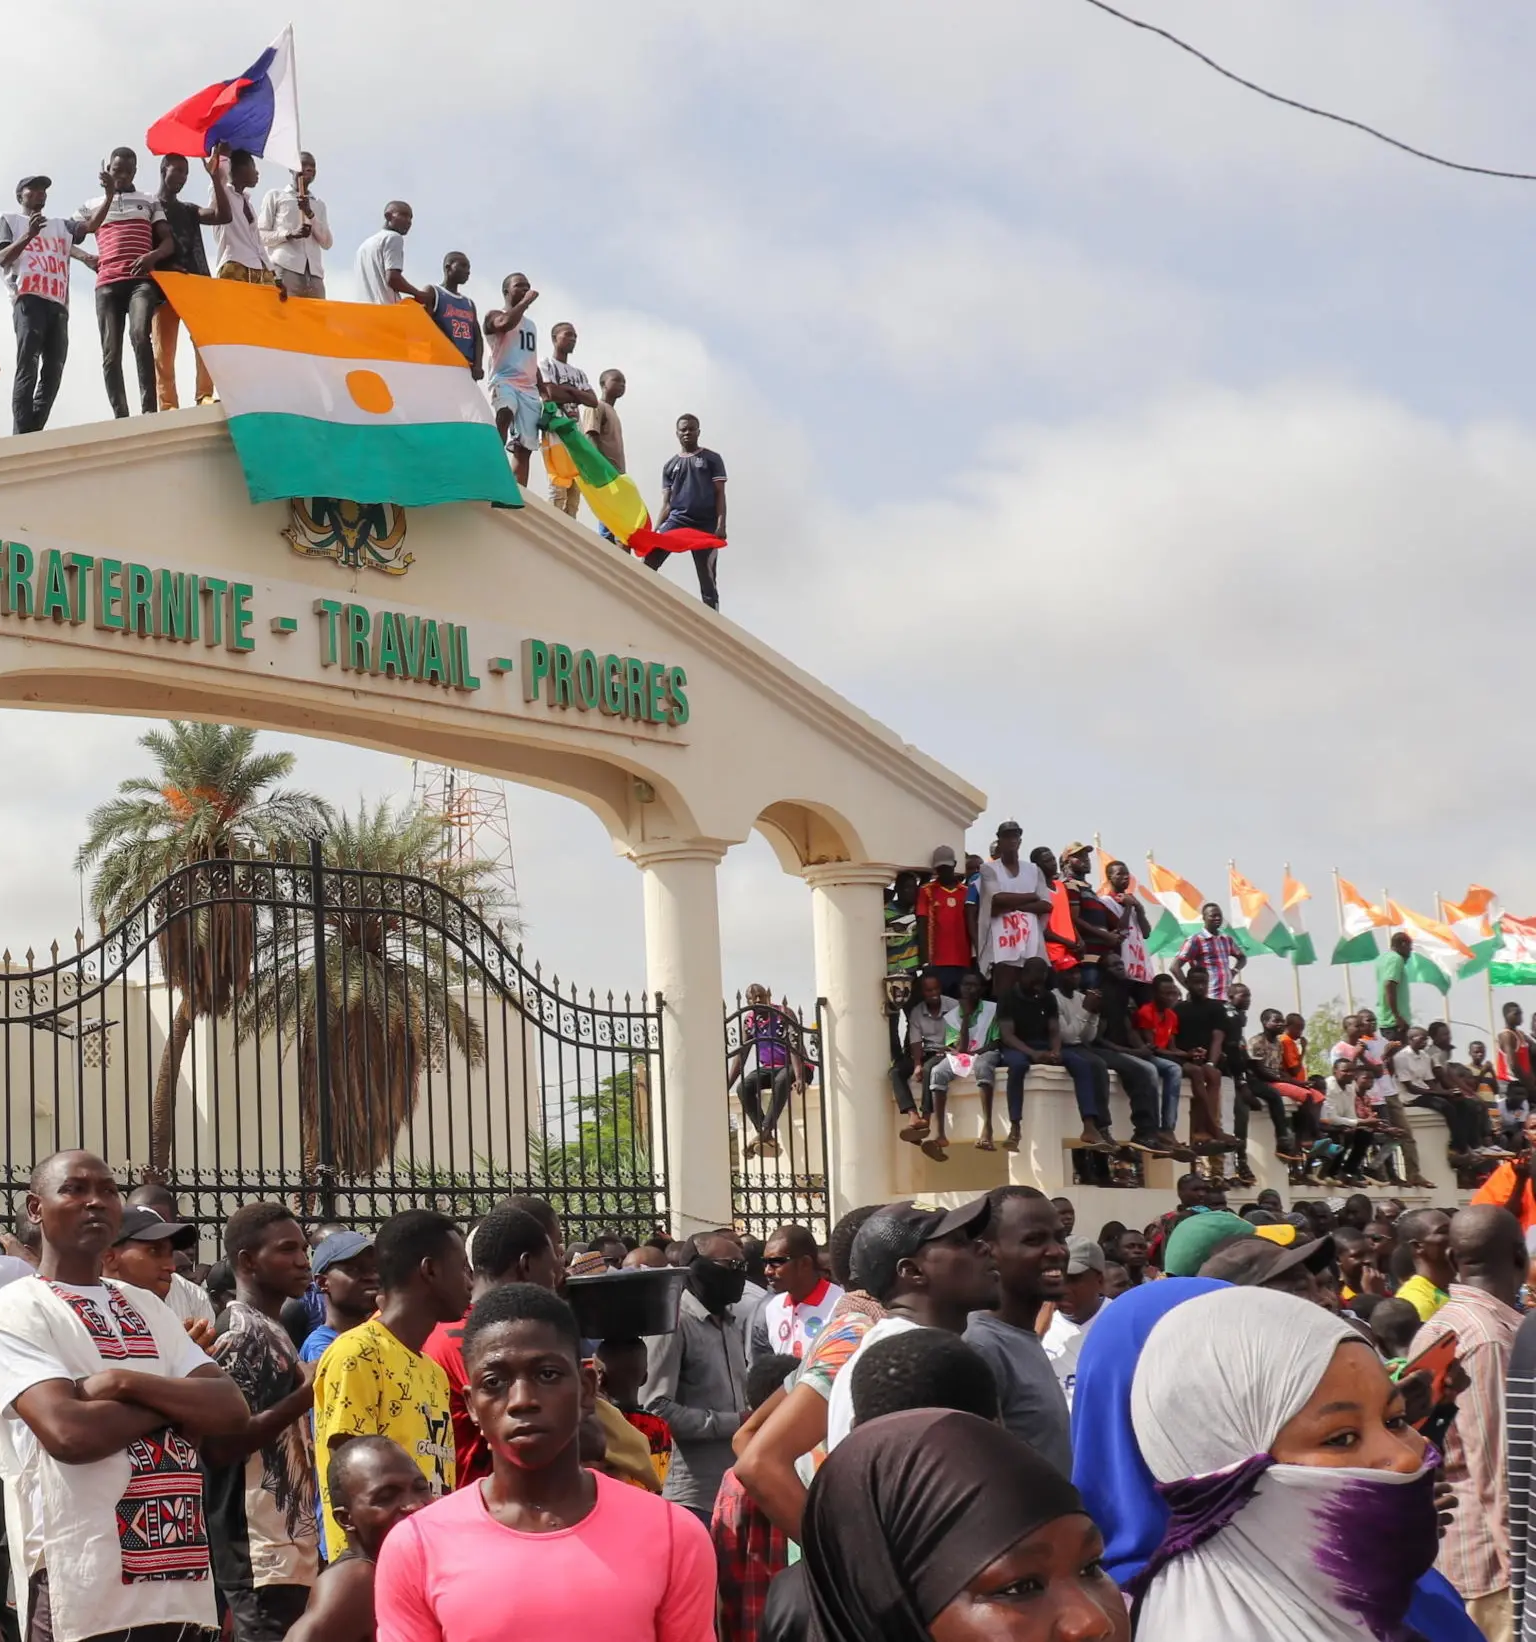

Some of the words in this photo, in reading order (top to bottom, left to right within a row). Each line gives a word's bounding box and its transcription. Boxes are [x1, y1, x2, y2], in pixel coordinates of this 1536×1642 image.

[519, 330, 535, 351] 10
[313, 598, 480, 691] TRAVAIL
[521, 637, 689, 726] PROGRES
